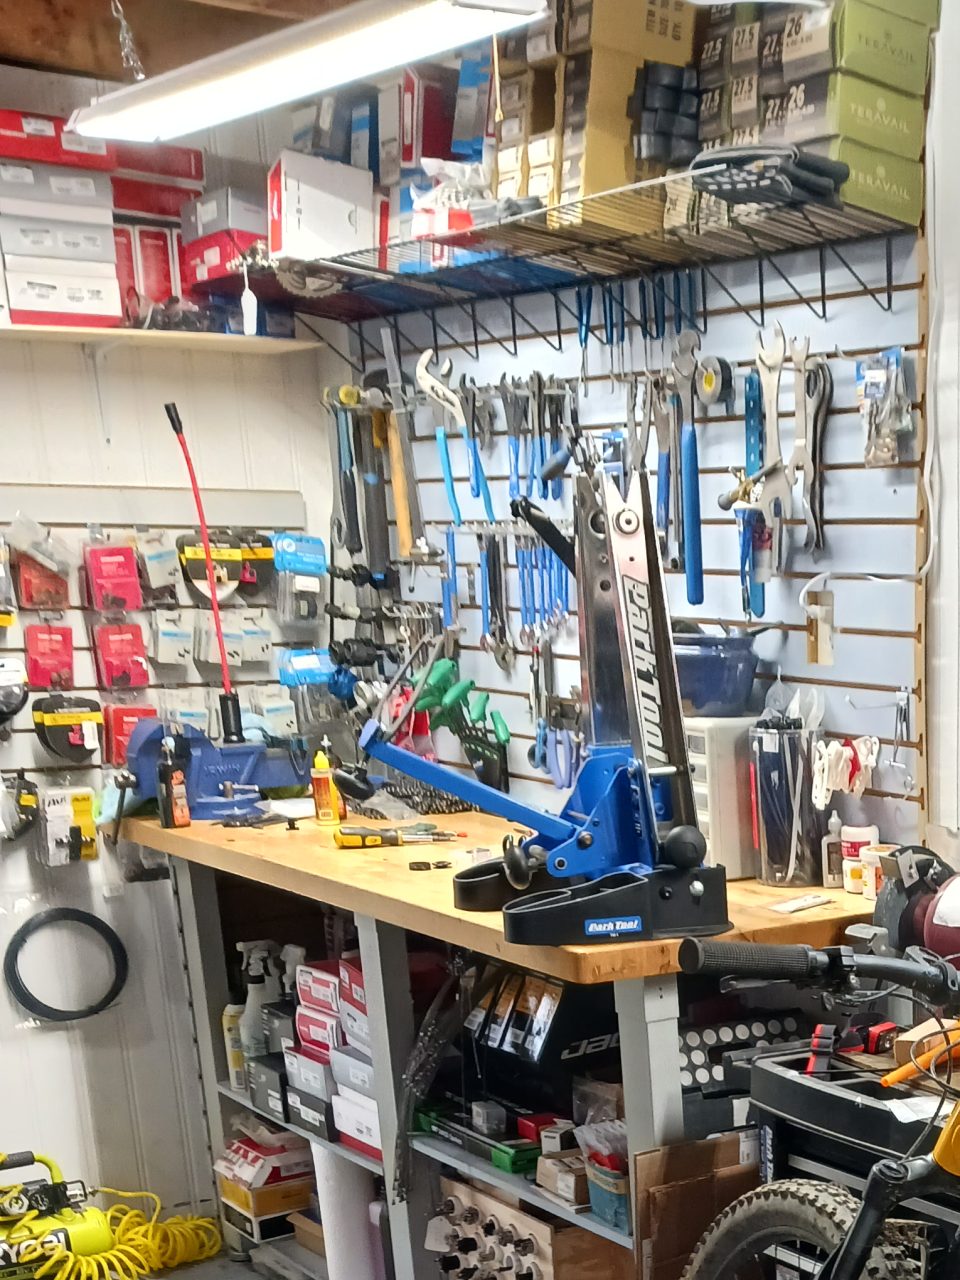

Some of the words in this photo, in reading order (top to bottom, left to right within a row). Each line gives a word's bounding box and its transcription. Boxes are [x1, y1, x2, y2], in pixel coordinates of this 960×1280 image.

[734, 26, 755, 47] 27.5
[787, 15, 803, 39] 26
[702, 38, 723, 60] 27.5
[733, 78, 755, 97] 27.5
[789, 83, 805, 108] 26
[850, 104, 910, 134] TERAVAIL
[203, 762, 241, 774] IRWIN
[588, 922, 614, 932] Park
[615, 920, 639, 930] Tool
